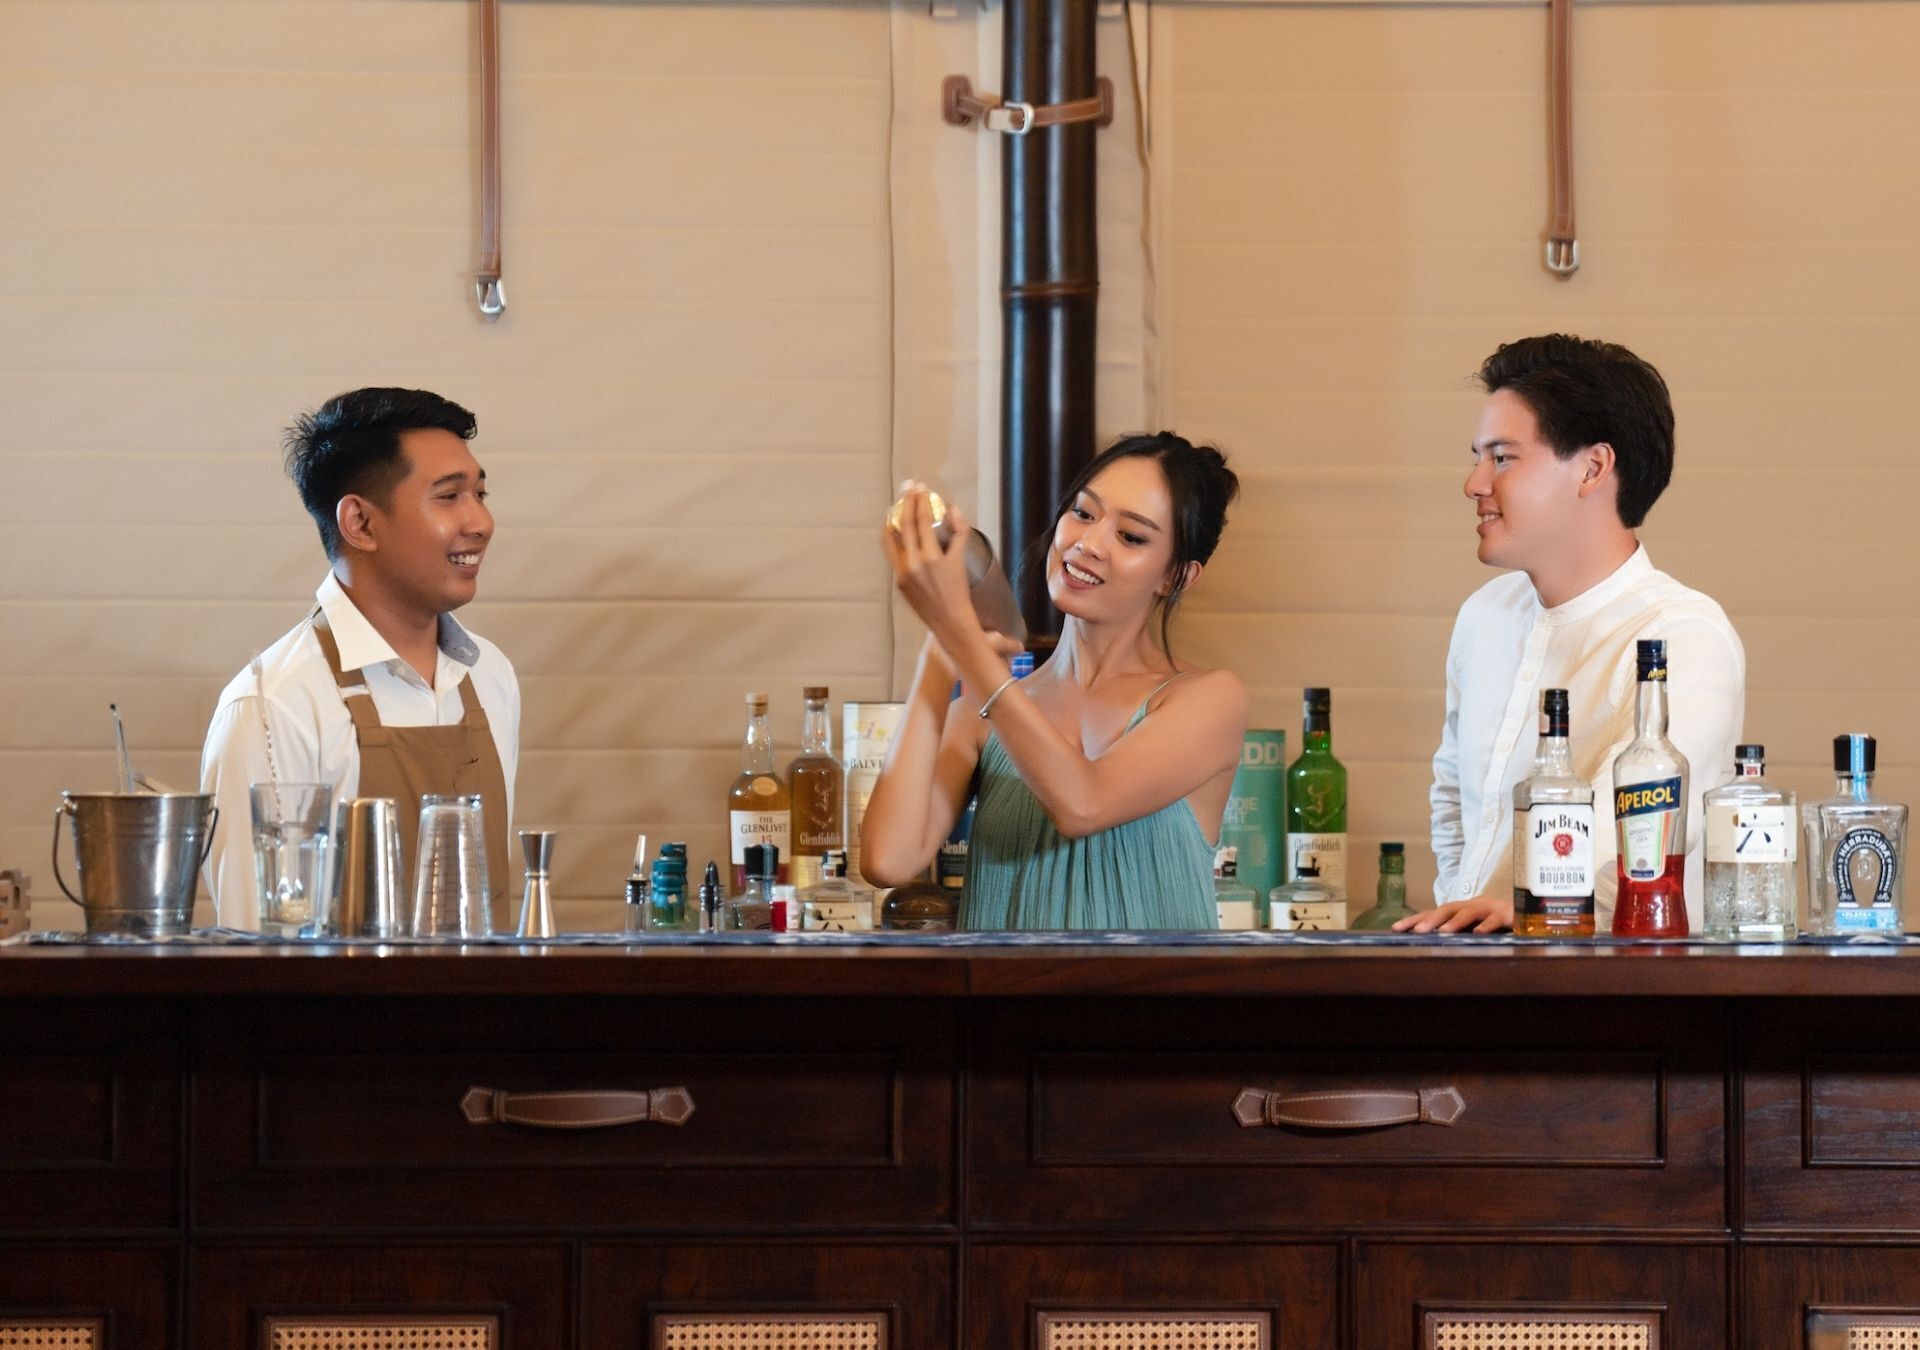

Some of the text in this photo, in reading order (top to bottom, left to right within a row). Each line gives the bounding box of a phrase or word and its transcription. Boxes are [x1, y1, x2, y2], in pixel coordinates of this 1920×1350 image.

[1616, 787, 1674, 814] APEROL
[759, 816, 774, 824] THE
[1535, 814, 1589, 839] JIM BEAM
[740, 823, 787, 834] GLENLIVET
[799, 831, 842, 846] Glenfiddich
[1294, 837, 1341, 852] Glenfiddich
[1839, 834, 1892, 859] HERRADURA
[1539, 871, 1585, 884] BOURBON
